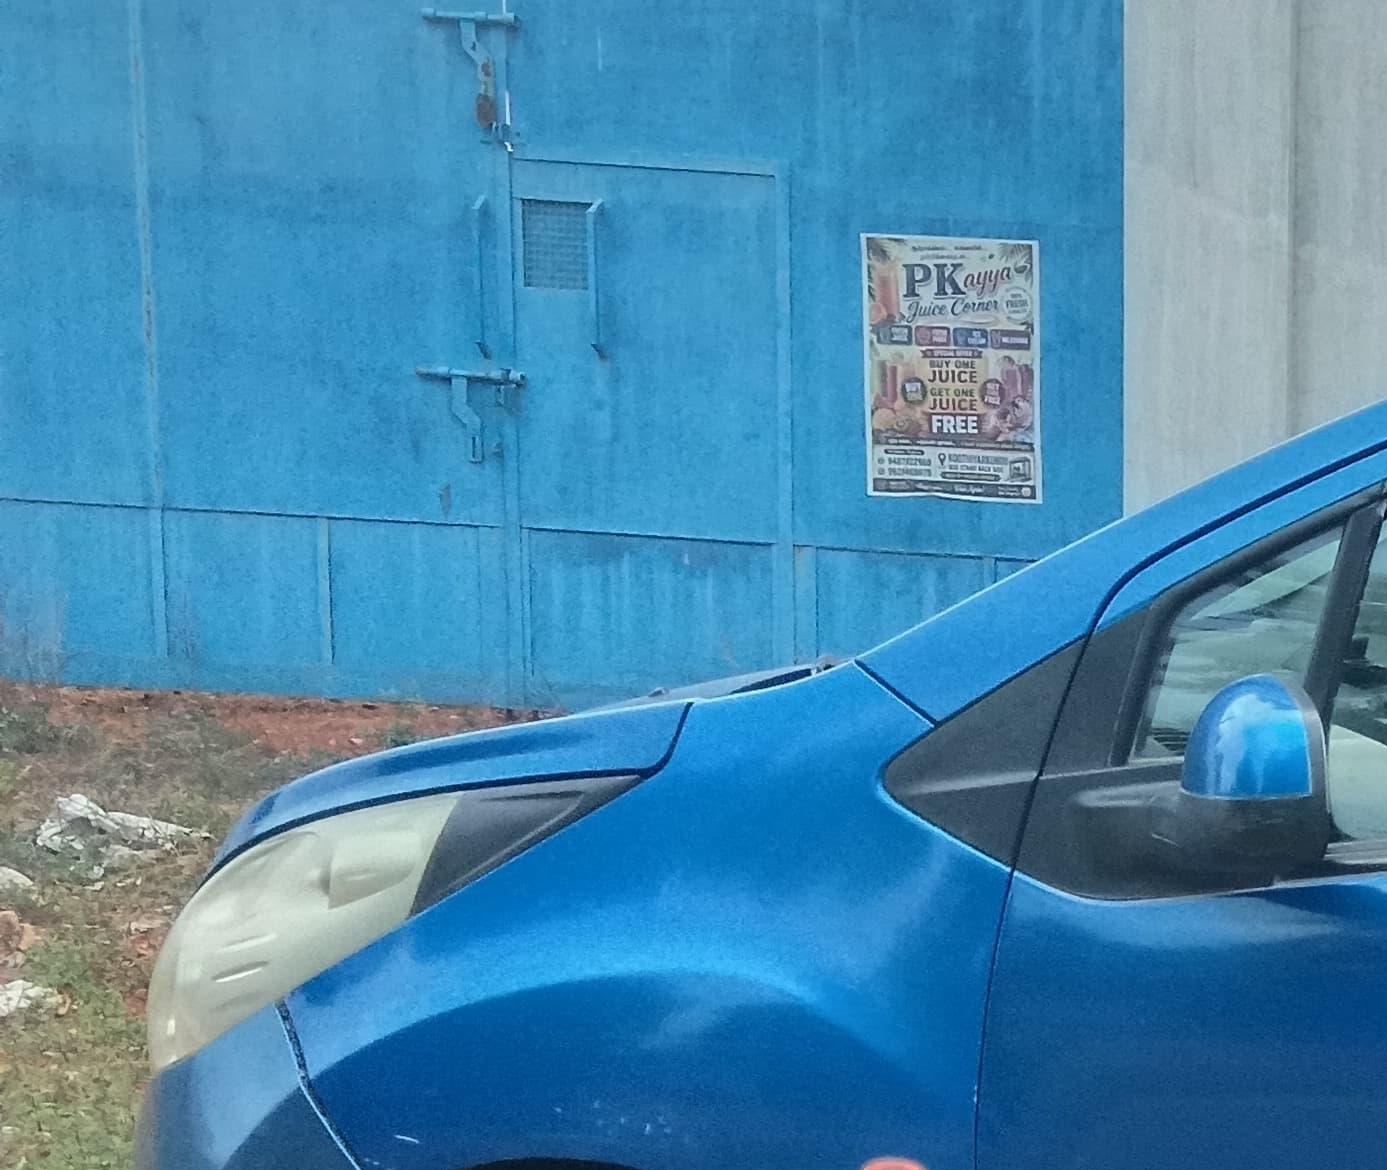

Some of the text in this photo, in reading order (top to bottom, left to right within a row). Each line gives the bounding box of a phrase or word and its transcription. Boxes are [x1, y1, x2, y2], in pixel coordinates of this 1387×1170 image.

[906, 298, 999, 323] Juice Corner
[928, 370, 977, 384] JUICE
[930, 387, 950, 397] GET
[954, 388, 976, 397] ONE
[929, 398, 977, 411] JUICE
[932, 414, 978, 433] FREE
